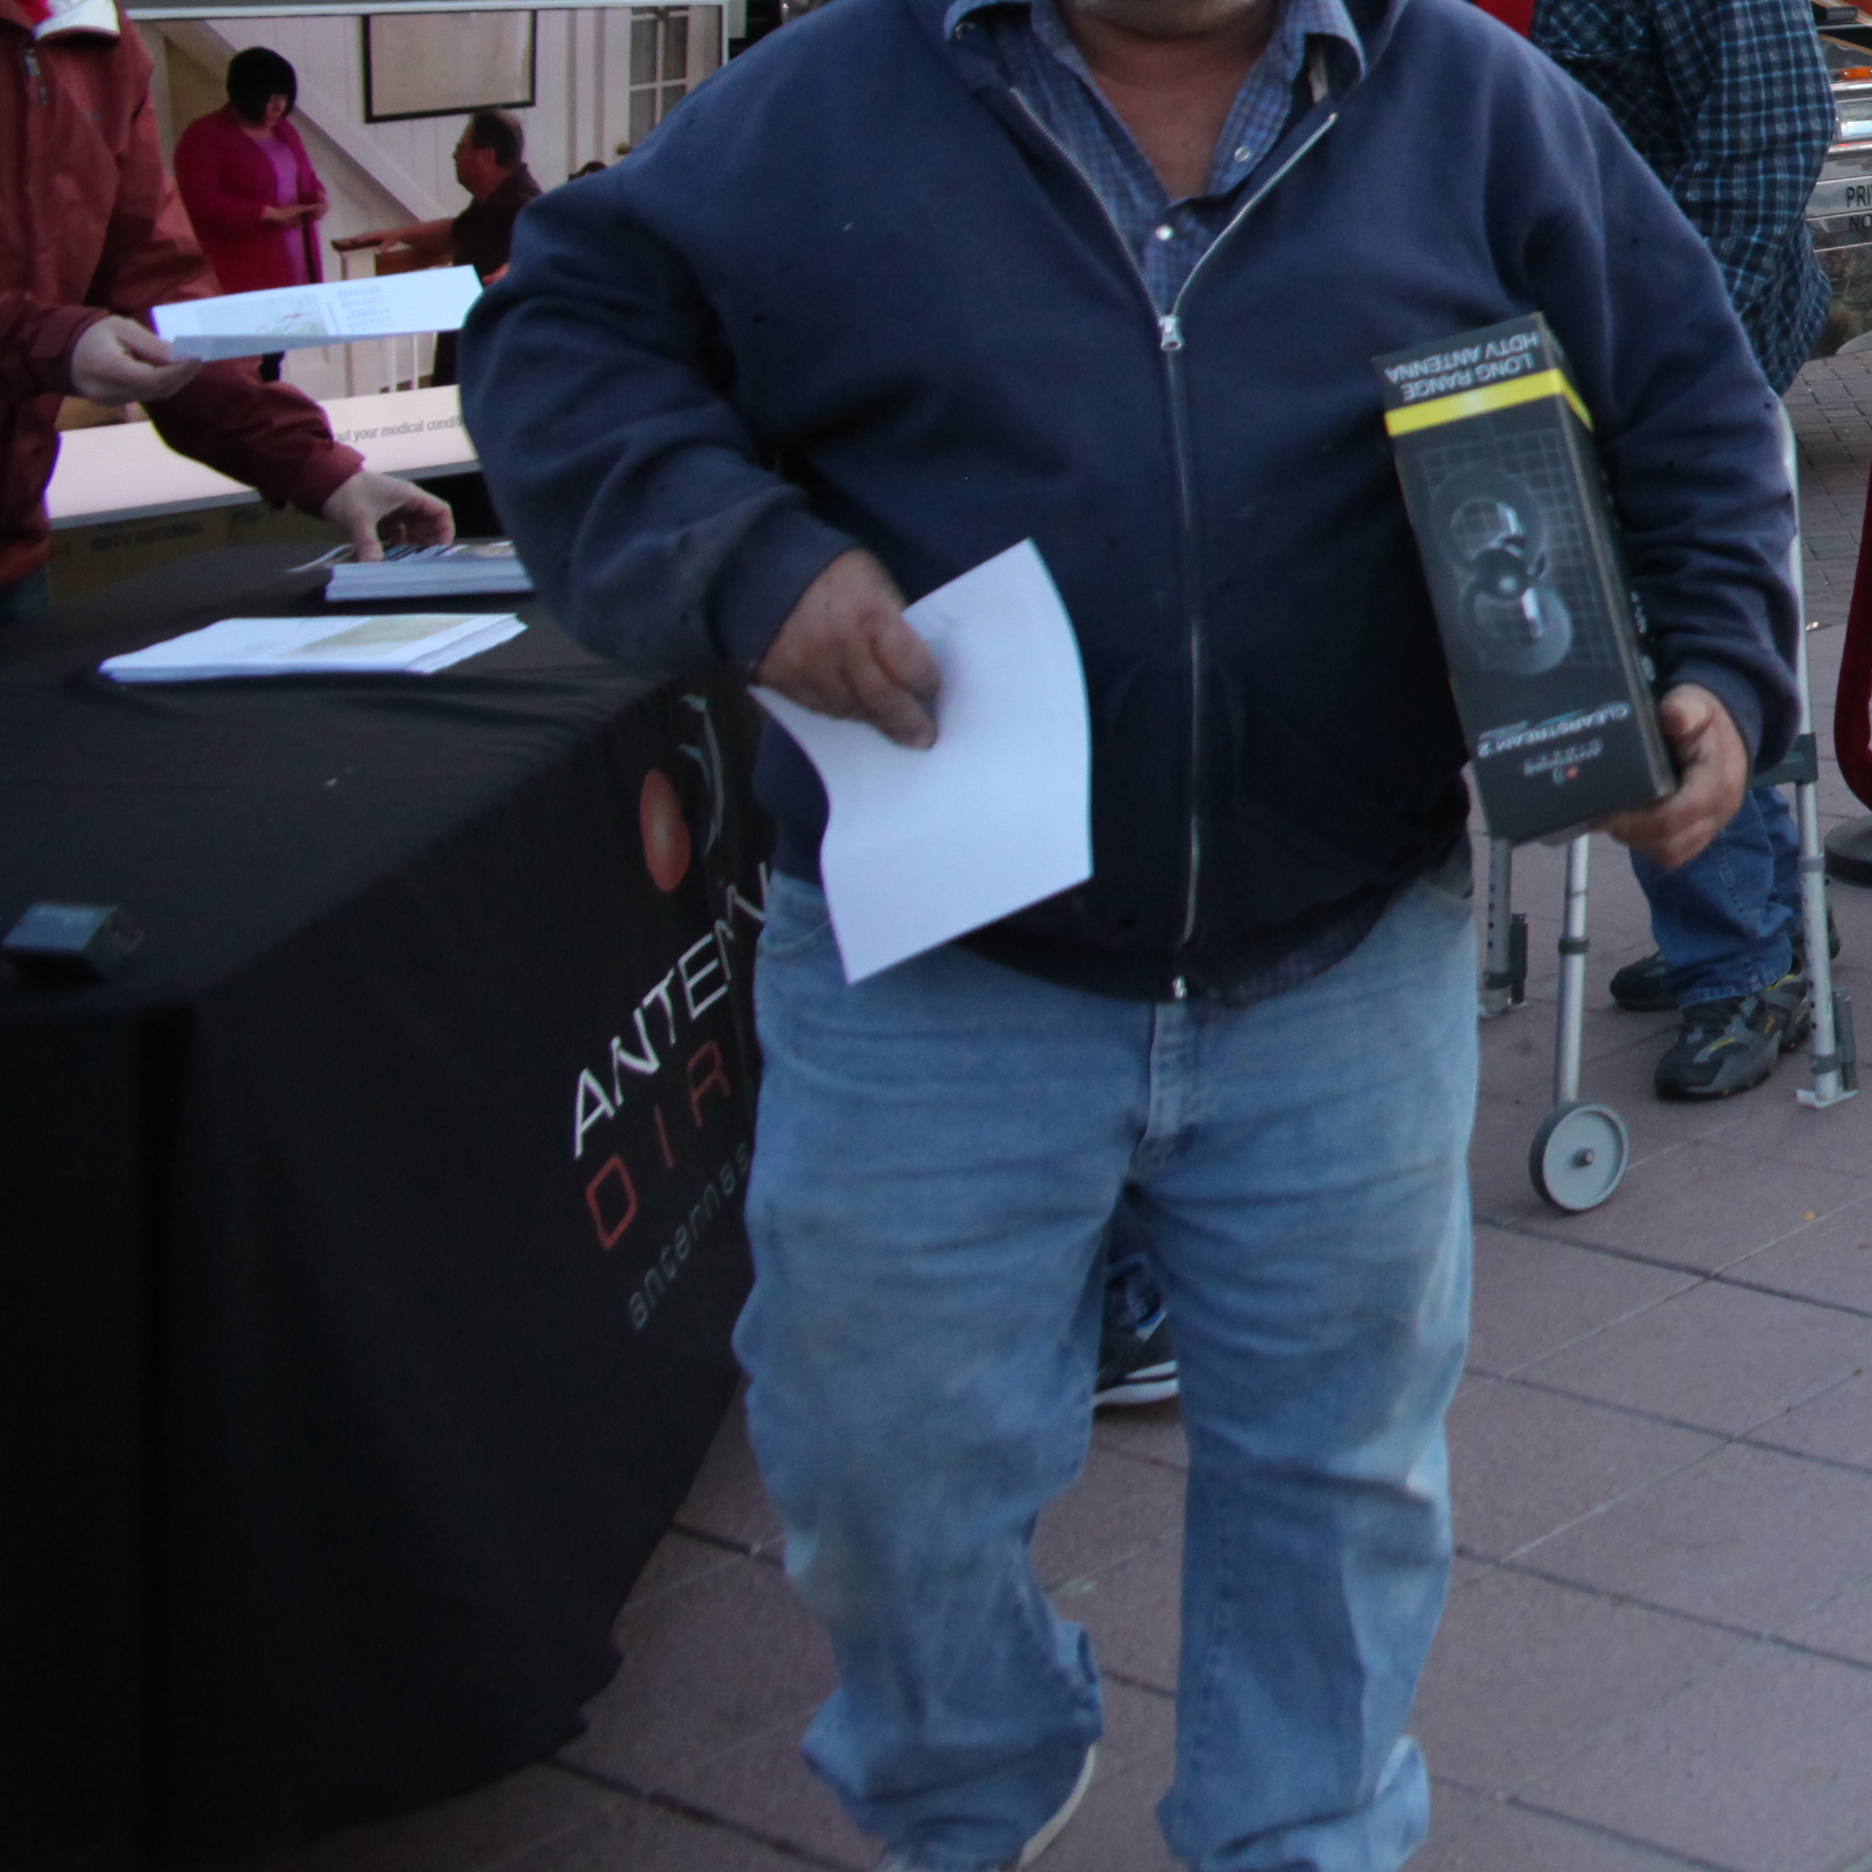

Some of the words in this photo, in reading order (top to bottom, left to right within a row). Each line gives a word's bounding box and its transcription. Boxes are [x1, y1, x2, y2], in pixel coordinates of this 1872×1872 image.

[1384, 344, 1482, 384] ANTENNA
[1485, 331, 1541, 359] HDTV
[1401, 367, 1475, 402] RANGE
[1474, 352, 1535, 382] LONG
[1495, 702, 1630, 753] CLEARSTREAM
[585, 1038, 732, 1250] DIR
[627, 1140, 751, 1331] antennas
